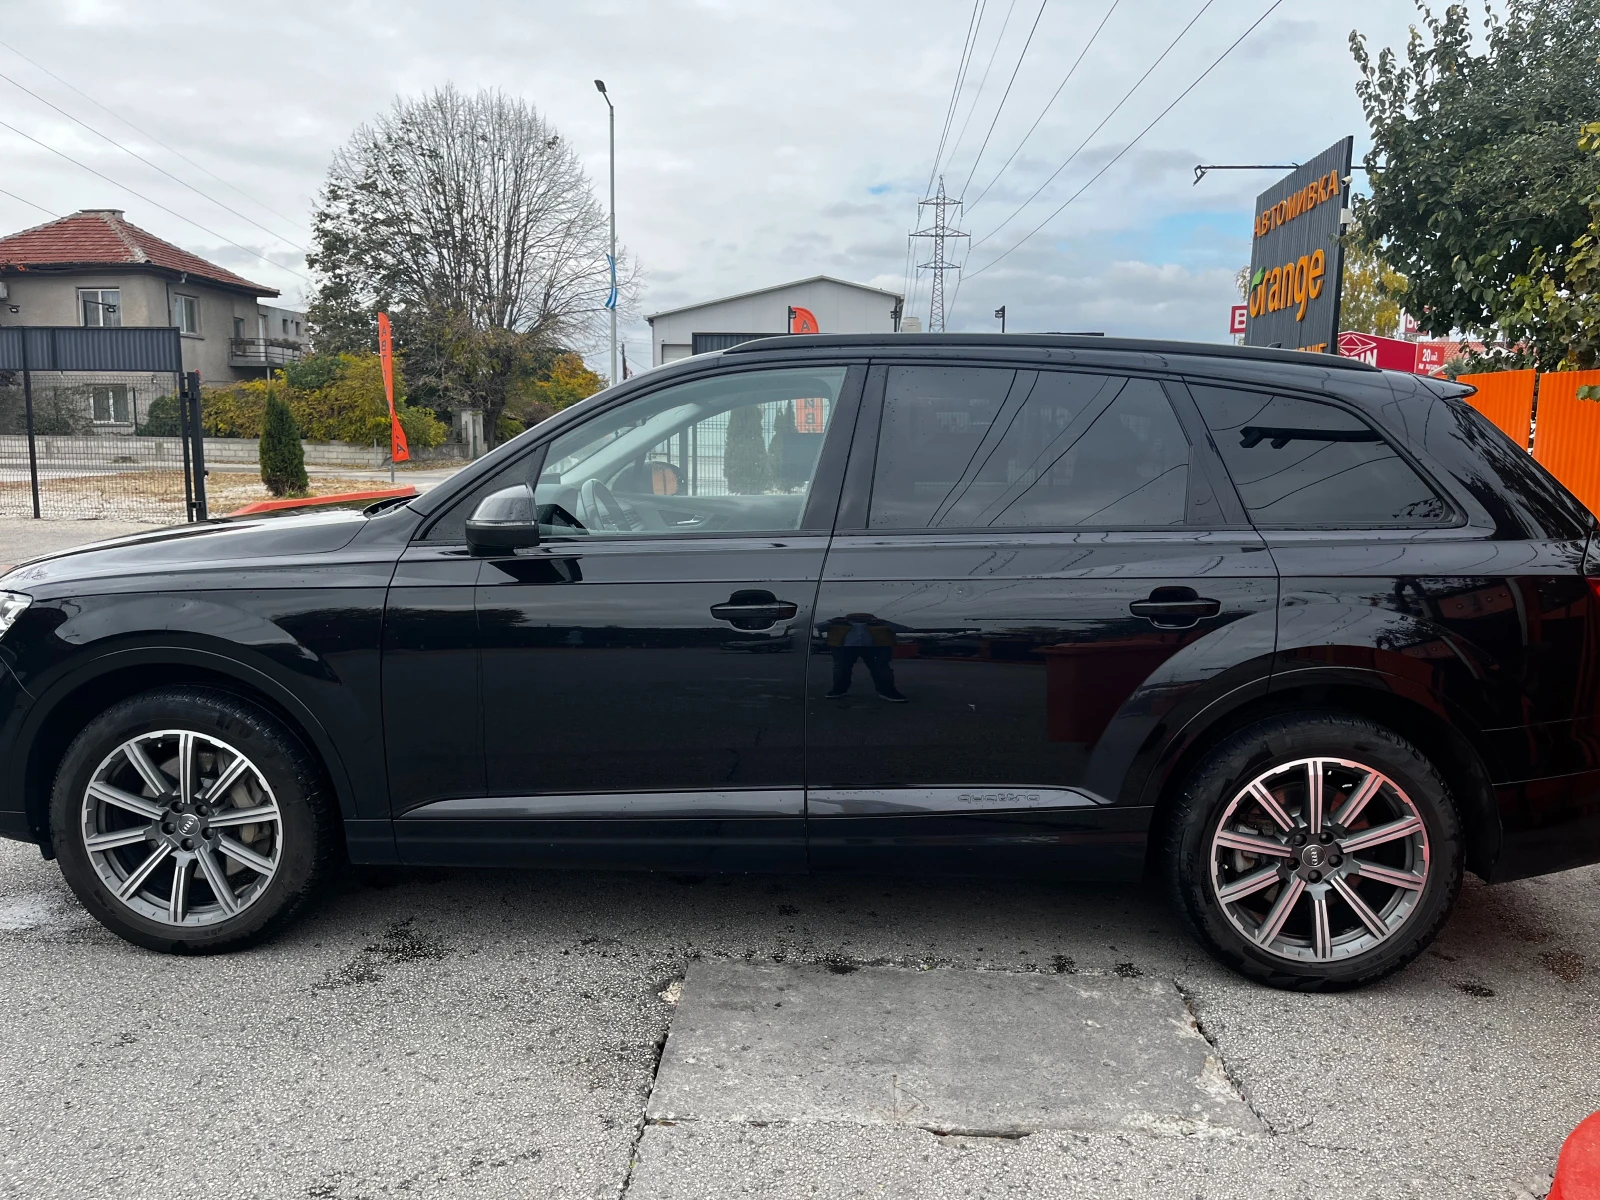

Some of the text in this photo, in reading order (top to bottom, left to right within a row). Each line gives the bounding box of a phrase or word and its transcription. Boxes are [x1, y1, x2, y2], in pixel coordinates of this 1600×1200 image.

[1253, 169, 1340, 239] АВТОМИВКА
[1422, 348, 1431, 362] 20
[958, 793, 1040, 804] quattro
